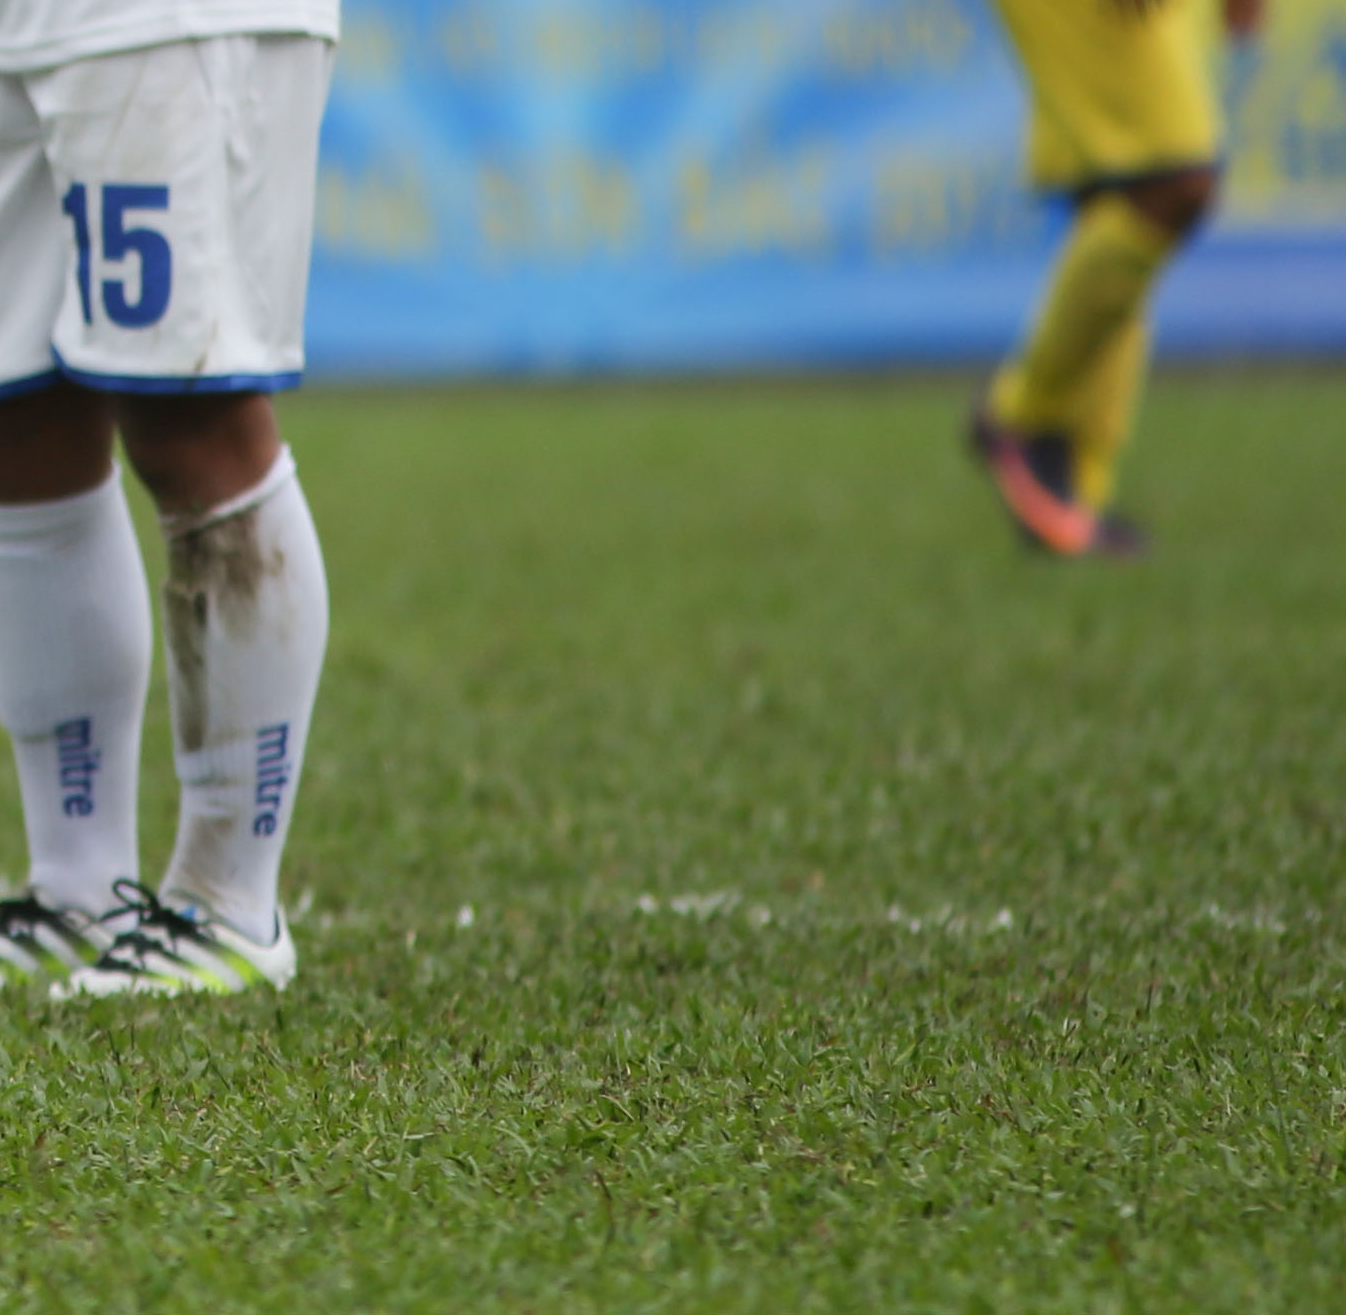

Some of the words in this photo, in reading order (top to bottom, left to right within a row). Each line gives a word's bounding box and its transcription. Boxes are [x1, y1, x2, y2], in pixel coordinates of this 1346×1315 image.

[62, 182, 172, 330] 15
[56, 715, 102, 818] mitre
[252, 722, 292, 838] mitre
